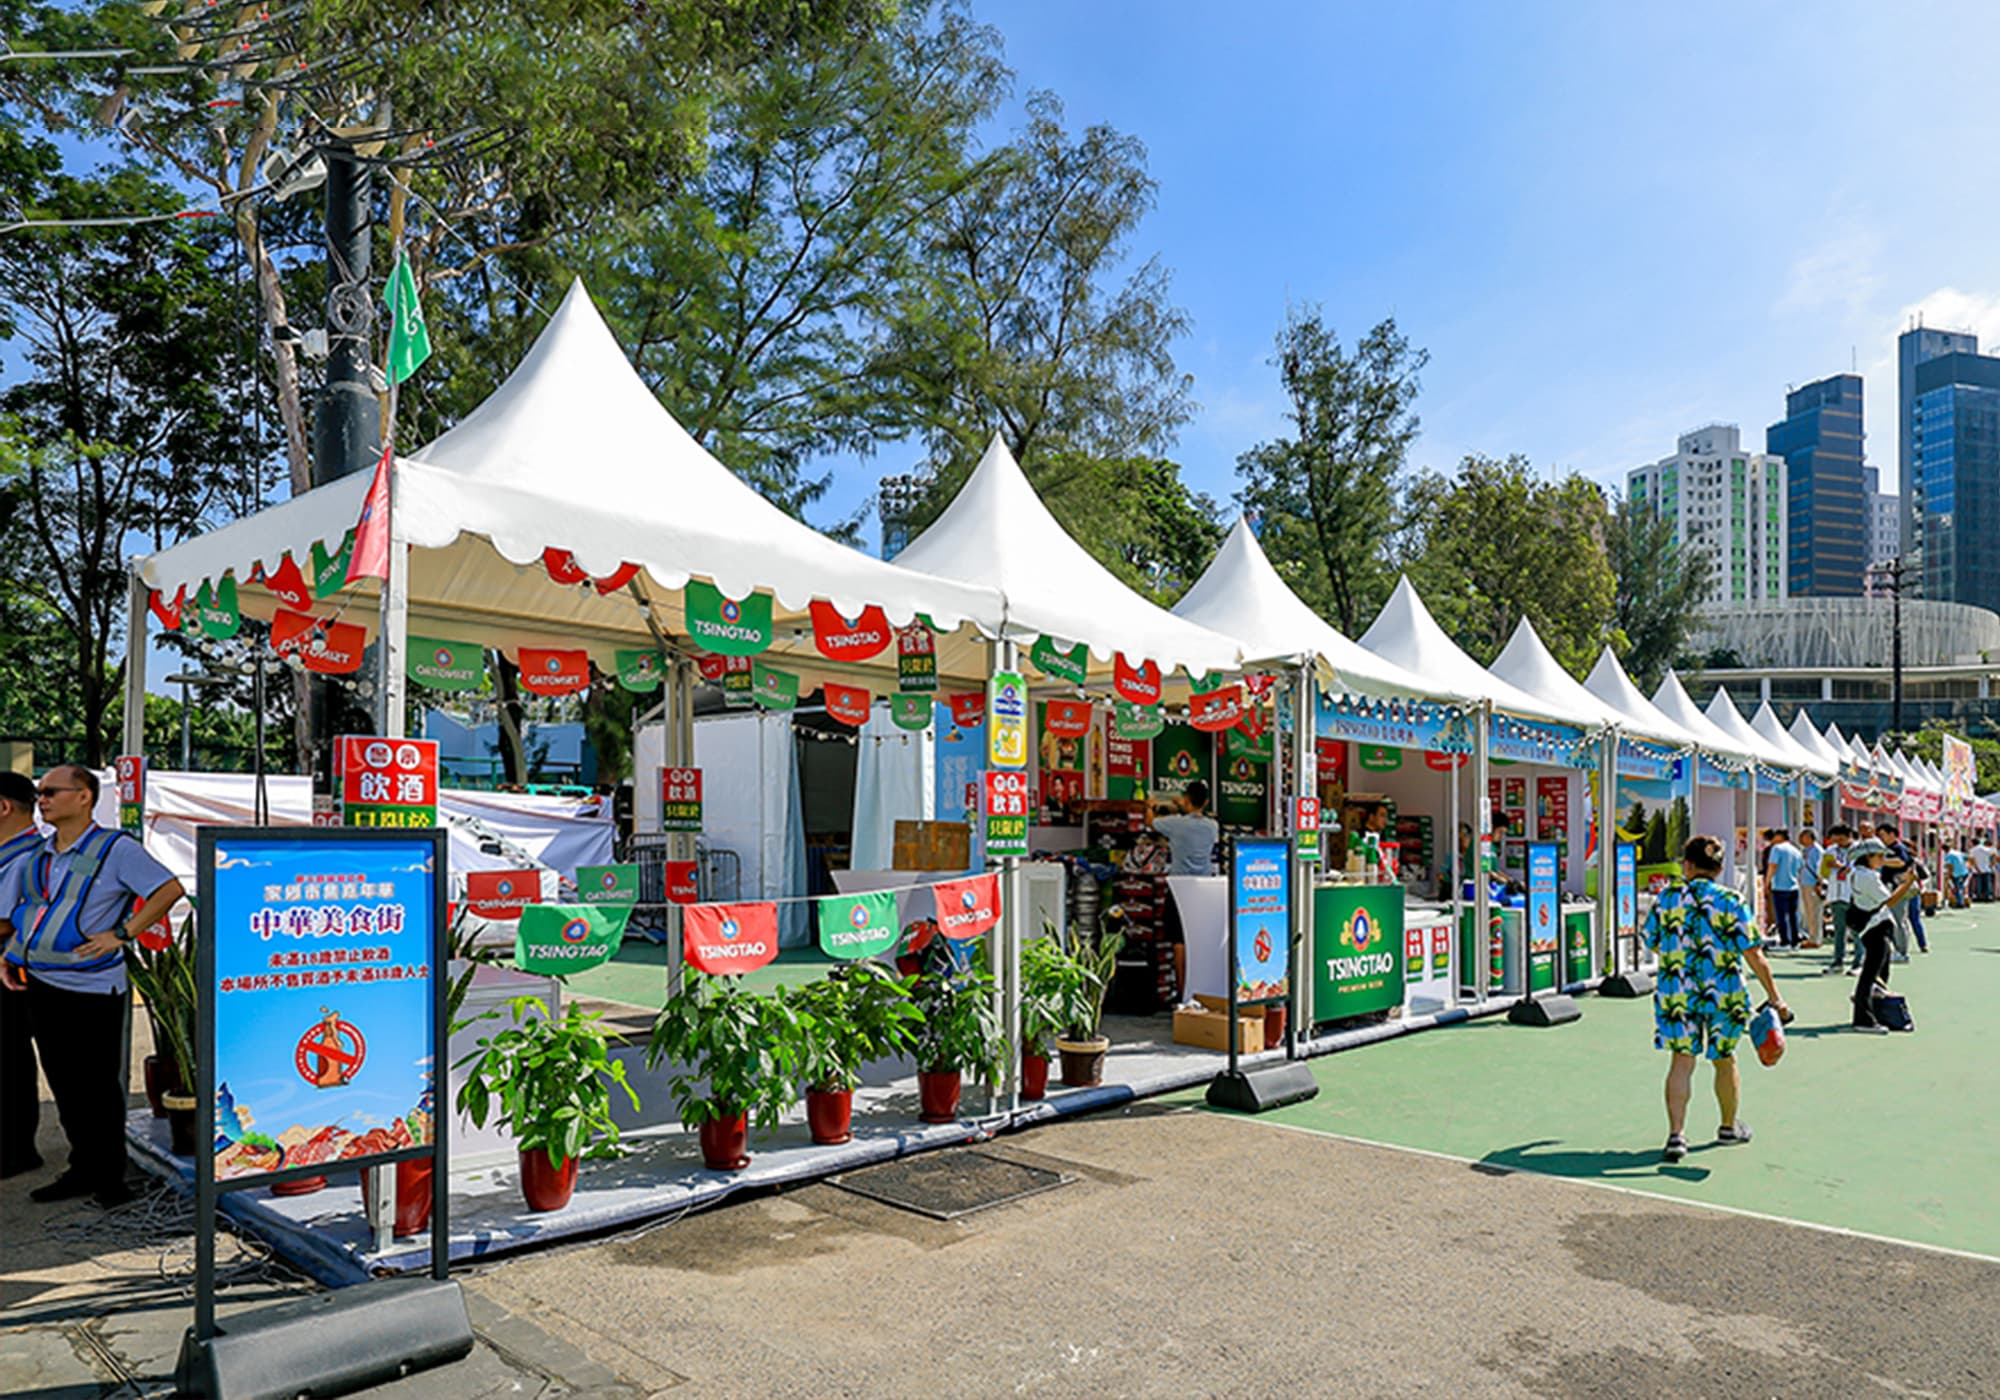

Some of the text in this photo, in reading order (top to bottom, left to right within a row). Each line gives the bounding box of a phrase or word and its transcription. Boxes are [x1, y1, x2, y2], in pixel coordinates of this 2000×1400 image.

[694, 619, 762, 643] TSINGTAO
[825, 631, 880, 649] TSINGTAO
[1120, 679, 1156, 696] TSINGTAO
[361, 772, 425, 802] 飲酒
[1221, 780, 1265, 796] TSINGTAO
[993, 794, 1022, 814] 飲酒
[250, 903, 405, 940] 中華美食街
[269, 947, 391, 968] 未滿18歲禁止飲酒
[528, 944, 608, 959] TSINGTAO
[698, 941, 767, 959] TSINGTAO
[1327, 952, 1393, 981] TSINGTAO
